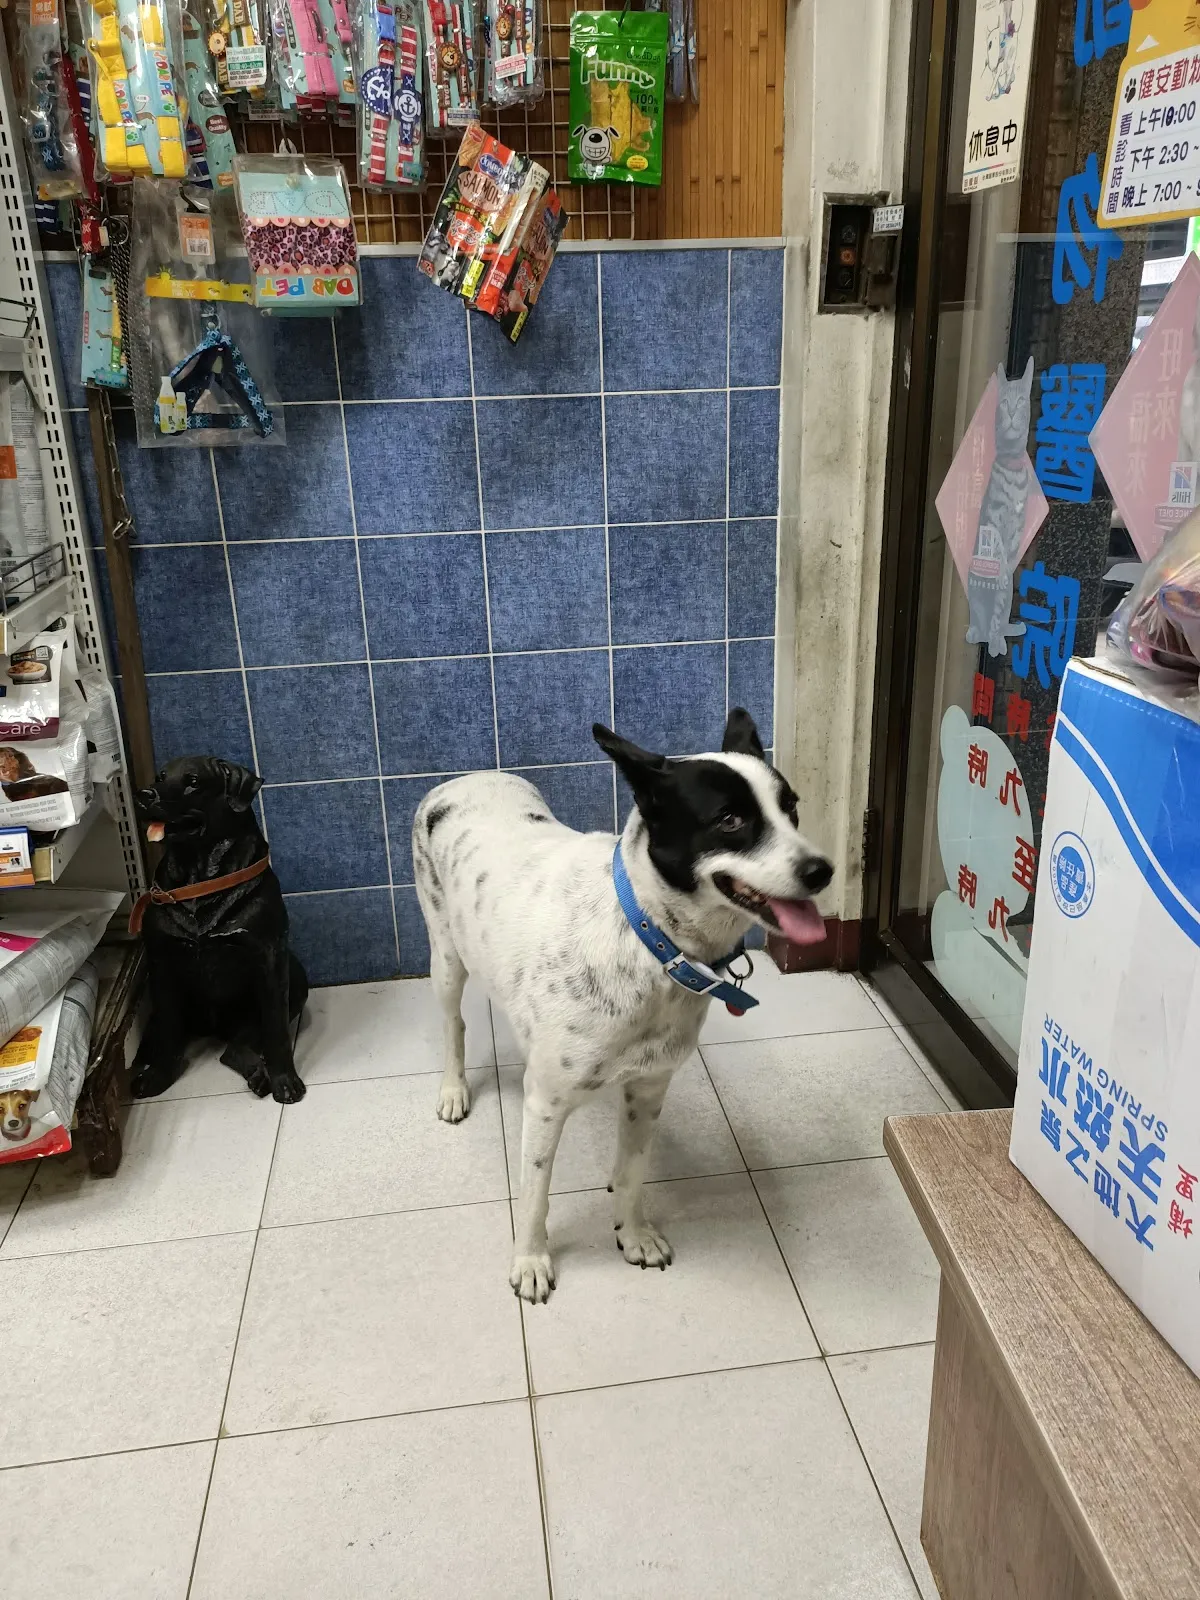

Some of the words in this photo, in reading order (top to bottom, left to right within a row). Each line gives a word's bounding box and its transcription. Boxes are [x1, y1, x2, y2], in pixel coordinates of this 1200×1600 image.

[217, 61, 228, 84] DAB
[580, 53, 656, 90] Funny
[969, 119, 1018, 164] 休息中
[1130, 146, 1156, 173] 下午
[1159, 141, 1189, 166] 2:30
[462, 171, 502, 206] SALMON
[1122, 183, 1148, 209] 晚上
[1152, 180, 1182, 204] 7:00
[260, 277, 306, 297] PET
[311, 277, 355, 297] DAB
[1043, 1012, 1093, 1077] WATER
[1039, 1036, 1167, 1205] 天然水
[1096, 1068, 1169, 1142] SPRING
[1039, 1099, 1158, 1252] 大地之泉
[1167, 1164, 1200, 1240] 埔里
